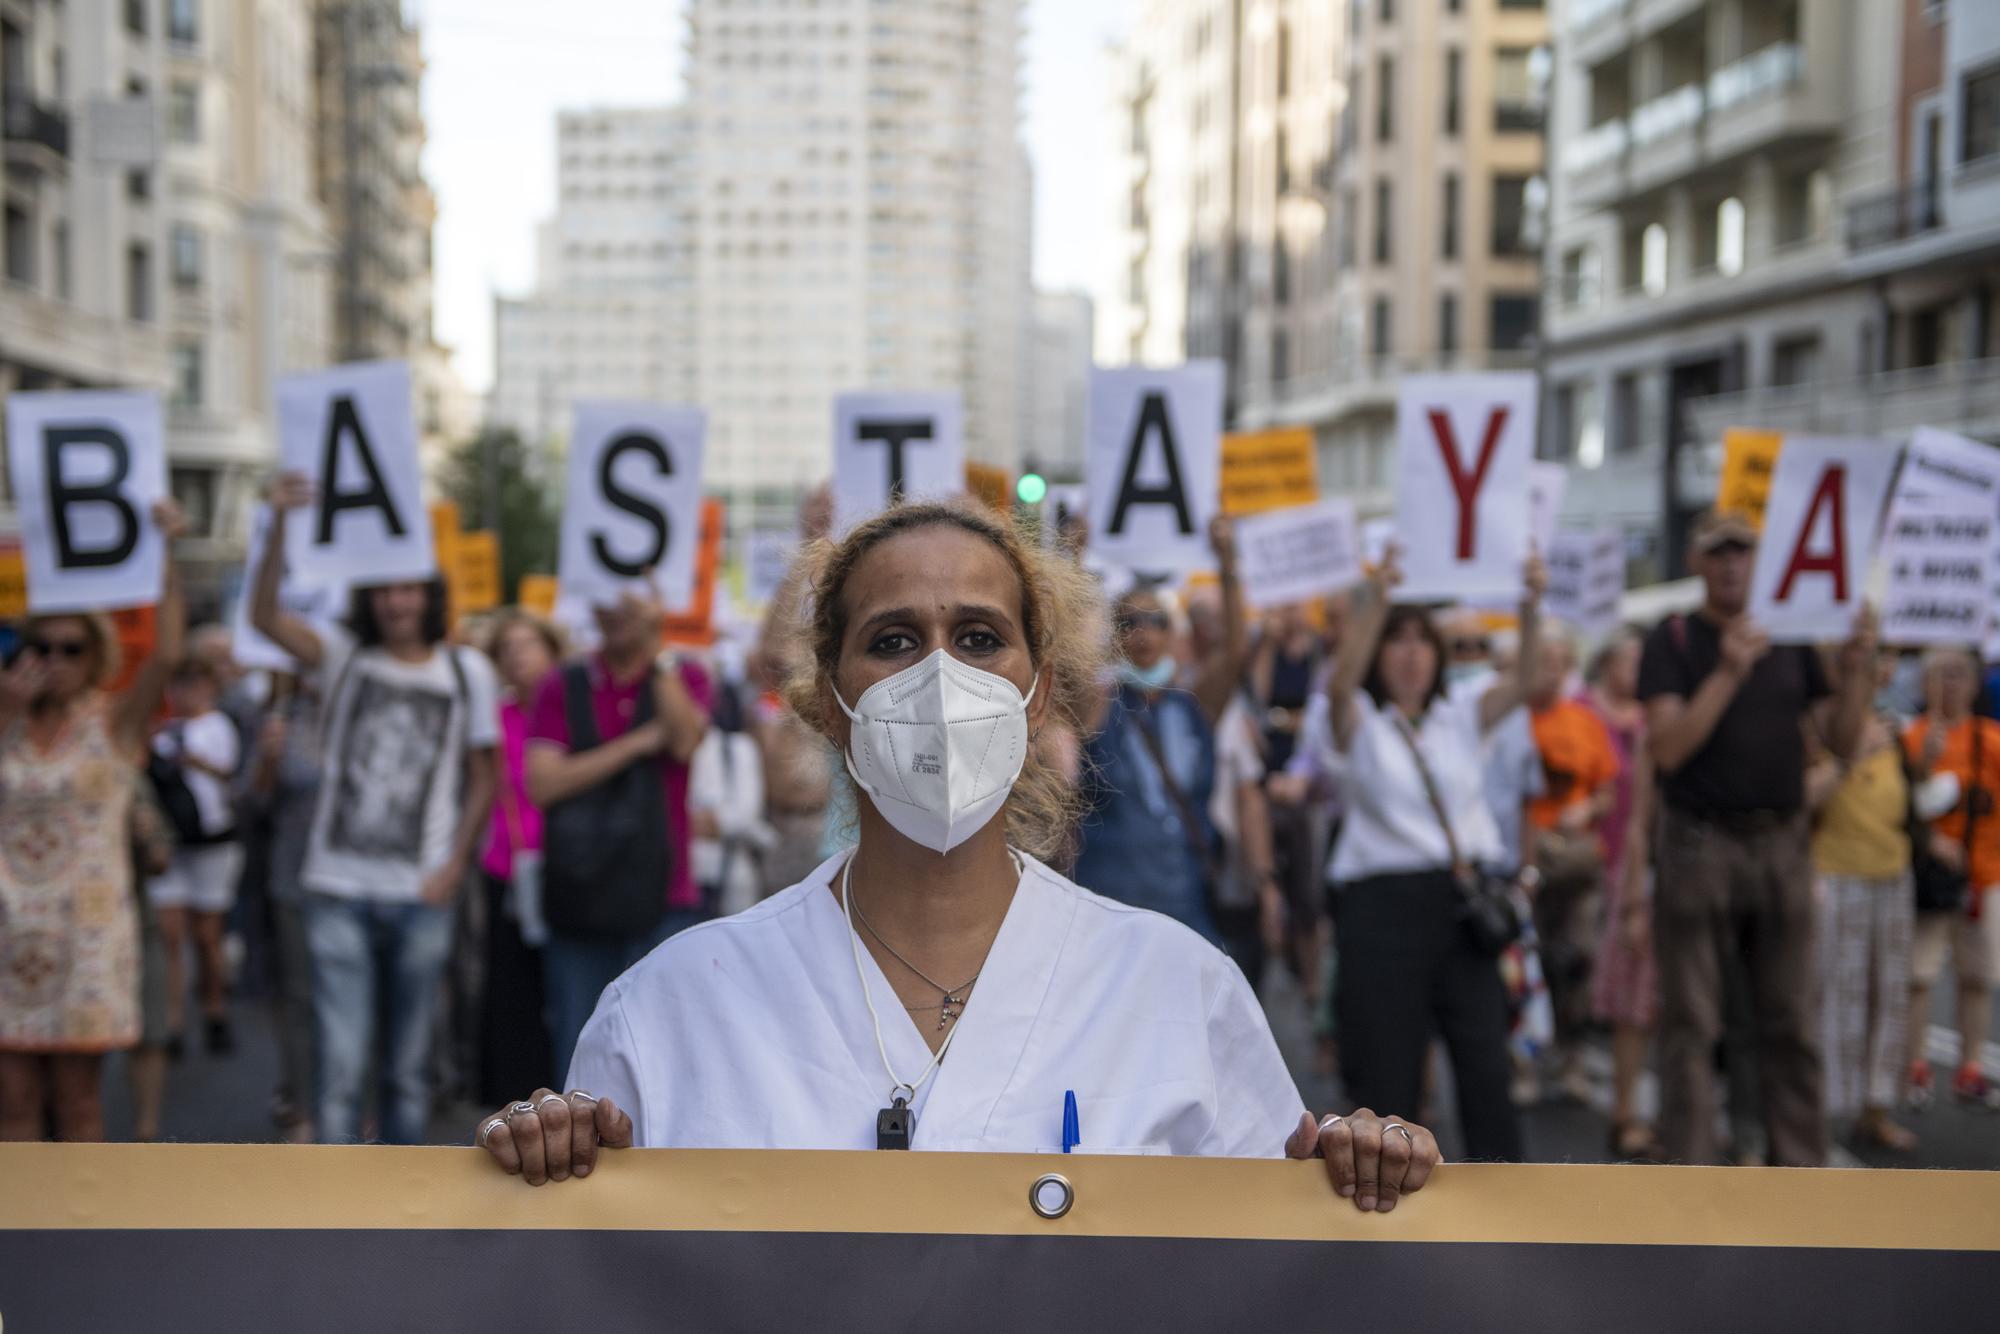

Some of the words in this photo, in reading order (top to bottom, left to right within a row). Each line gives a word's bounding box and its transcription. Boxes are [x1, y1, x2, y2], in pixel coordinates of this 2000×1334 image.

[43, 425, 141, 571] B
[315, 394, 409, 546] A
[587, 431, 676, 578] S
[855, 420, 935, 501] T
[1105, 391, 1196, 537] A
[1427, 407, 1510, 562] Y
[1772, 460, 1850, 605] A
